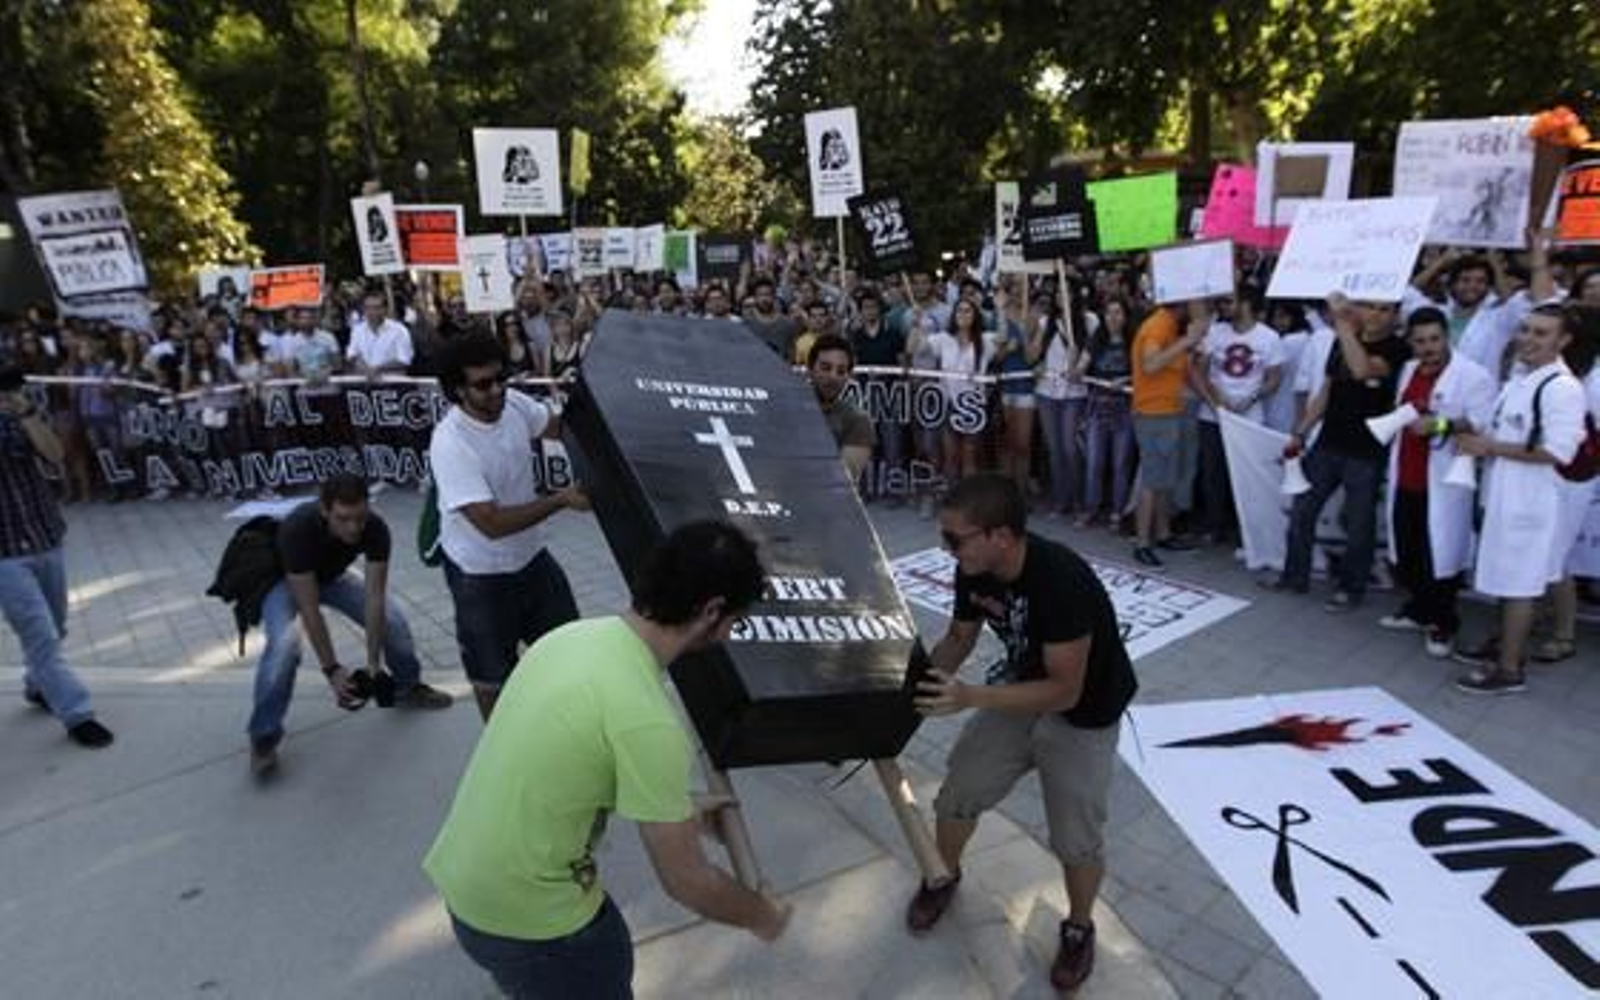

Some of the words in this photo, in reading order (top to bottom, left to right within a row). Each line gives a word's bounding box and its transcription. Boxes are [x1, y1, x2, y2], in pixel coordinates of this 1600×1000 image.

[36, 204, 124, 229] WANTED
[865, 211, 909, 247] 22
[635, 376, 769, 401] UNIVERSIDAD
[264, 388, 323, 428] AL
[184, 446, 432, 493] NIVERSIDA
[763, 576, 846, 600] ERT
